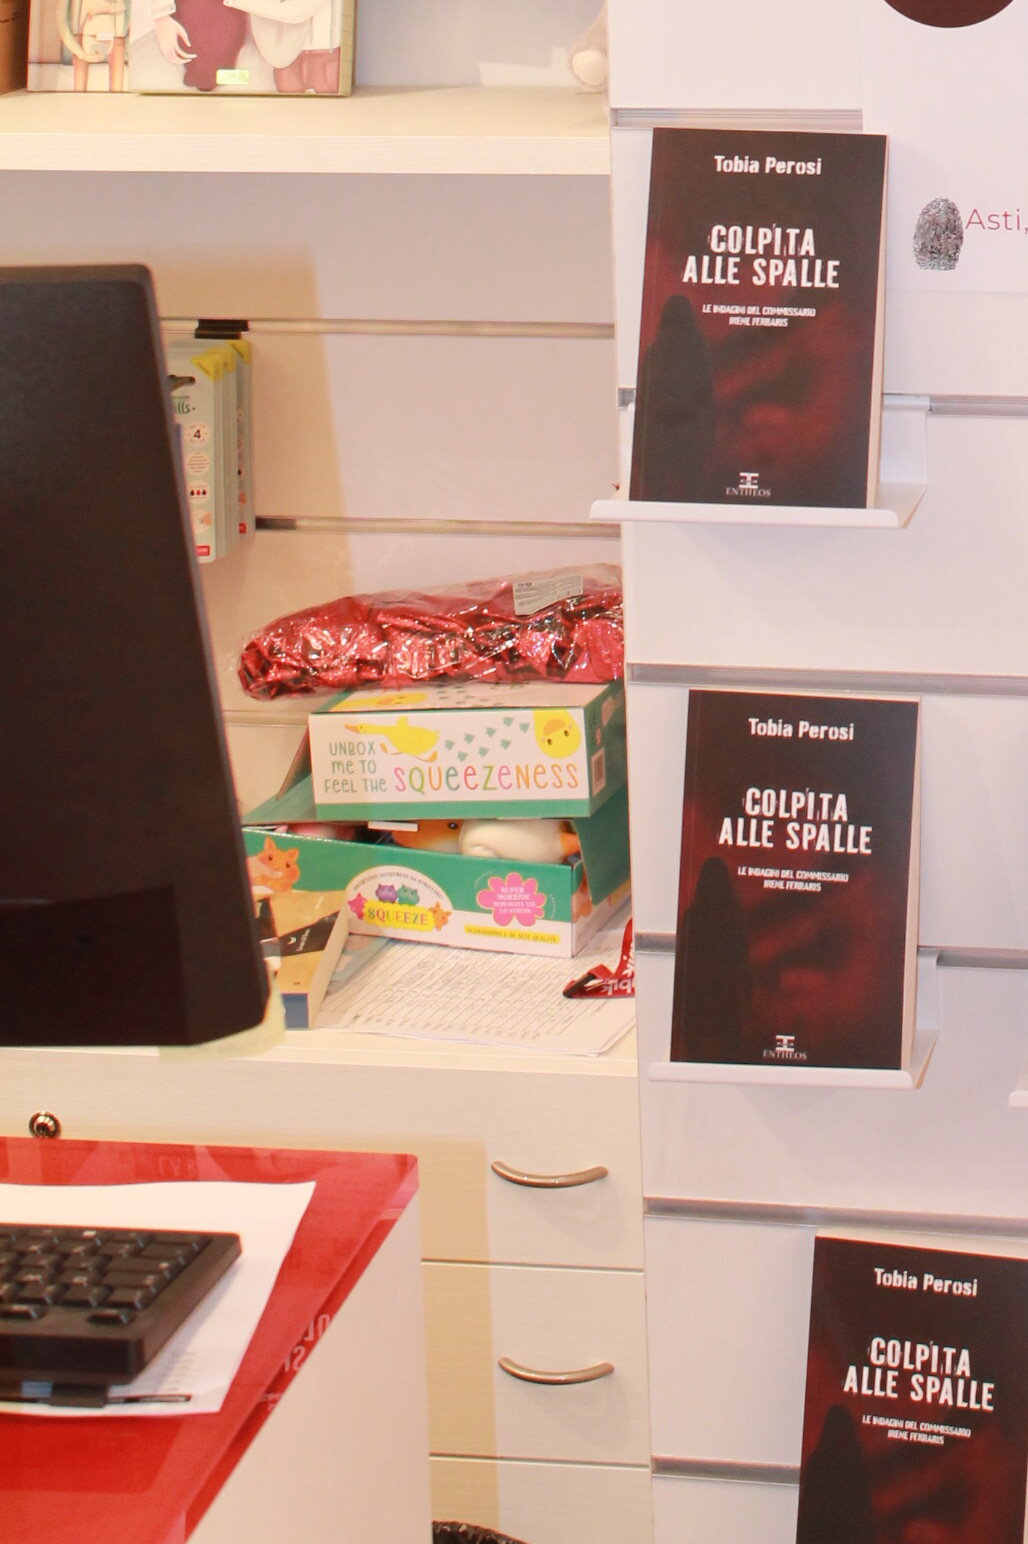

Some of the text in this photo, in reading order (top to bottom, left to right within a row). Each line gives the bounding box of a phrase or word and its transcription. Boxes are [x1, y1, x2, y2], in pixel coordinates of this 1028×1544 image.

[714, 155, 821, 175] Tobia Perosi
[965, 209, 1028, 234] Asti,
[711, 224, 815, 256] COLPITA
[683, 255, 839, 288] ALLE SPALLE
[748, 718, 854, 740] Tobia Perosi
[329, 741, 375, 756] UNBOX
[359, 760, 376, 774] TO
[745, 788, 847, 821] COLPITA
[719, 818, 872, 854] ALLE SPALLE
[368, 907, 428, 926] SQUEEZE
[874, 1268, 977, 1296] Tobia Perosi
[868, 1337, 970, 1382] COLPITA
[844, 1366, 994, 1411] ALLE SPALLE
